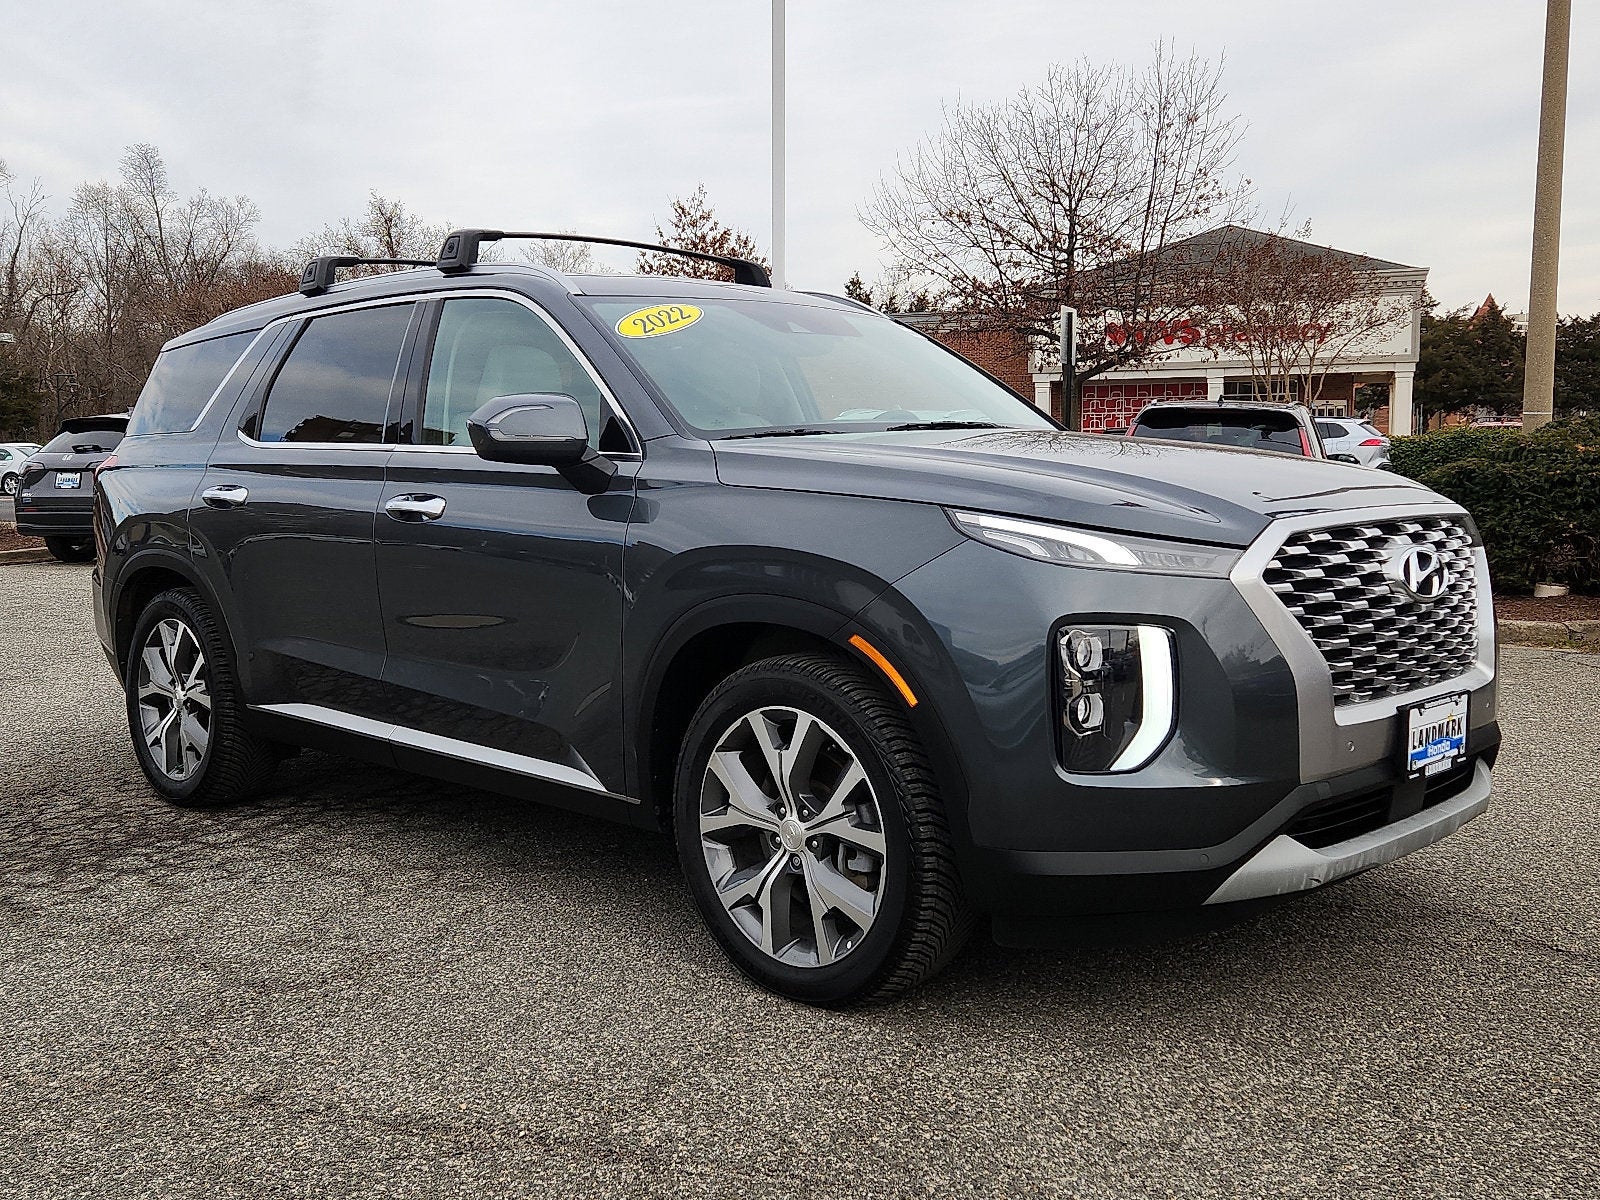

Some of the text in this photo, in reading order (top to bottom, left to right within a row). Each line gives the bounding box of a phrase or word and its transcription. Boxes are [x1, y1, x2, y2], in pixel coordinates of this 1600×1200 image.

[632, 306, 692, 334] 2022
[1134, 319, 1201, 345] CVS
[1412, 716, 1464, 750] LANDMARK
[1427, 740, 1451, 757] Honda
